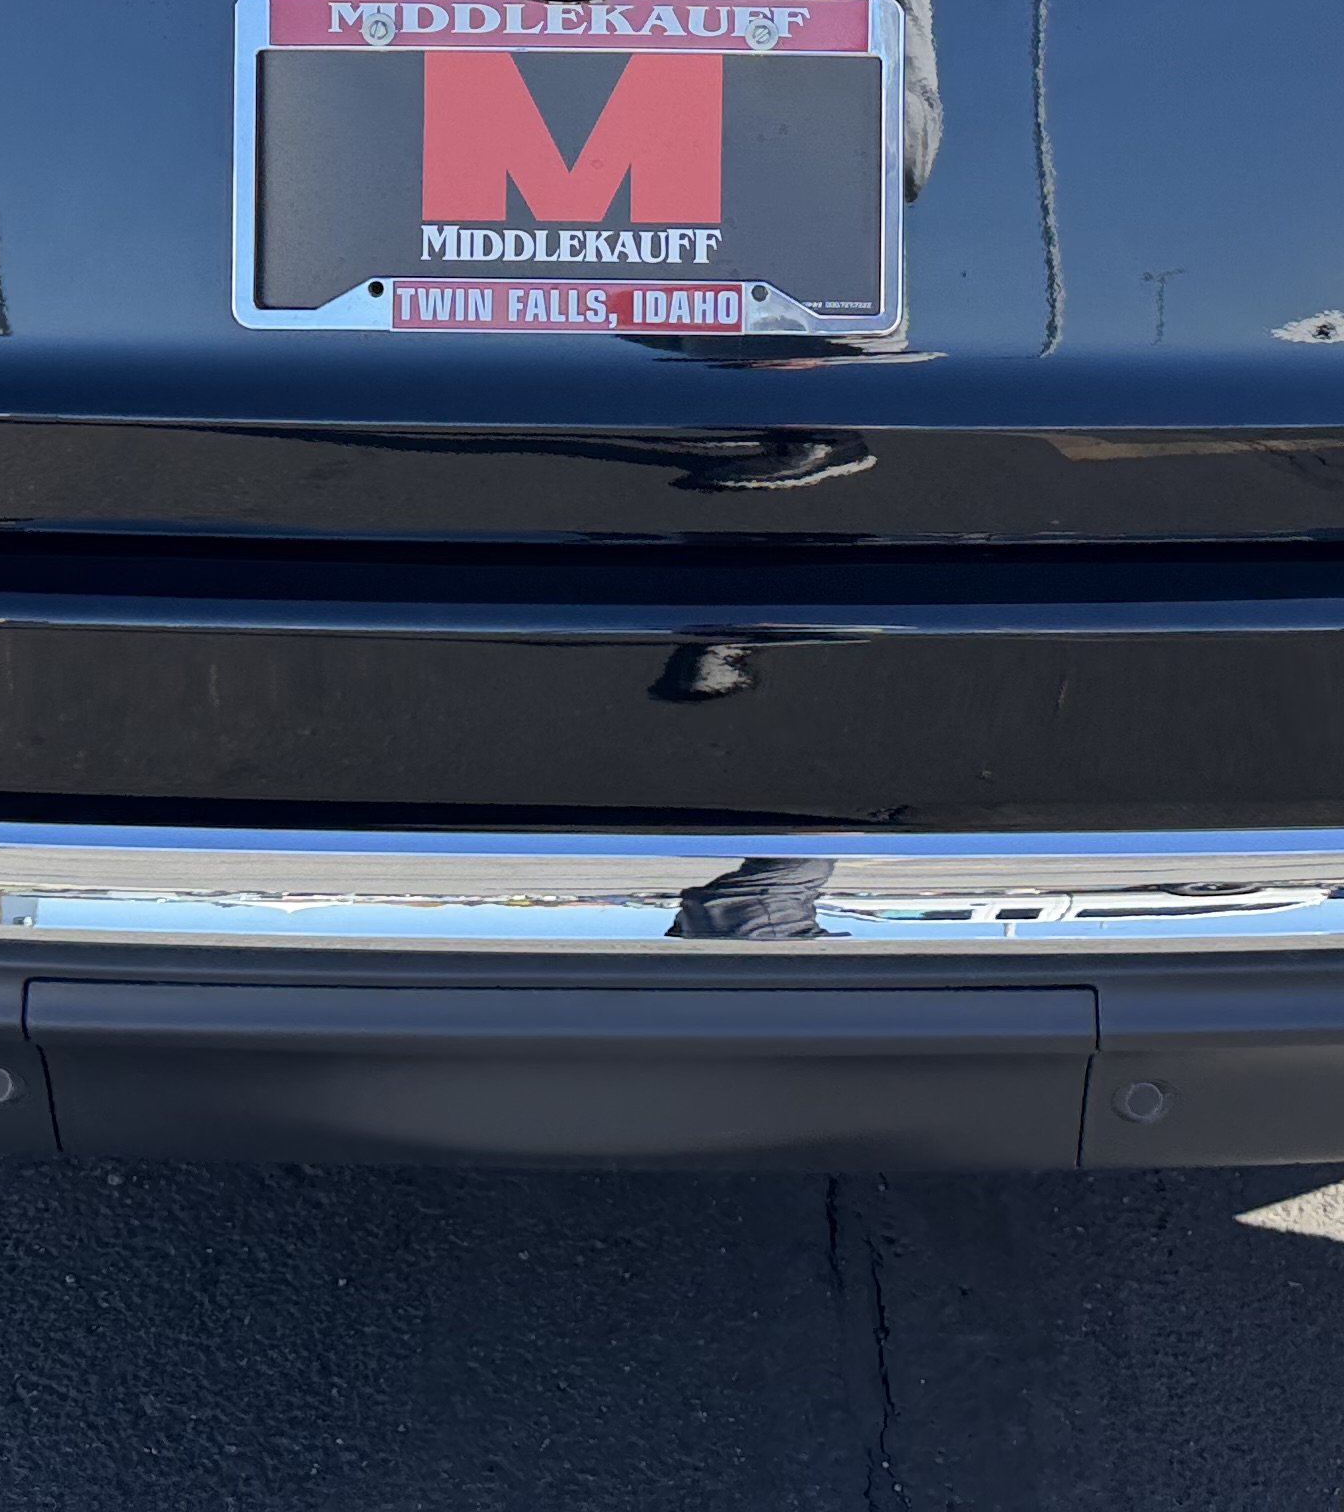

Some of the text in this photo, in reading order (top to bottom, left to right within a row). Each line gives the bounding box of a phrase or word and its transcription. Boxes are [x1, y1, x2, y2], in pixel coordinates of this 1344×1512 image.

[327, 1, 811, 38] MIDDLEKAUFF
[421, 50, 723, 224] M
[420, 224, 723, 265] MIDDLEKAUFF
[396, 287, 740, 329] TWIN FALLS, IDAHO
